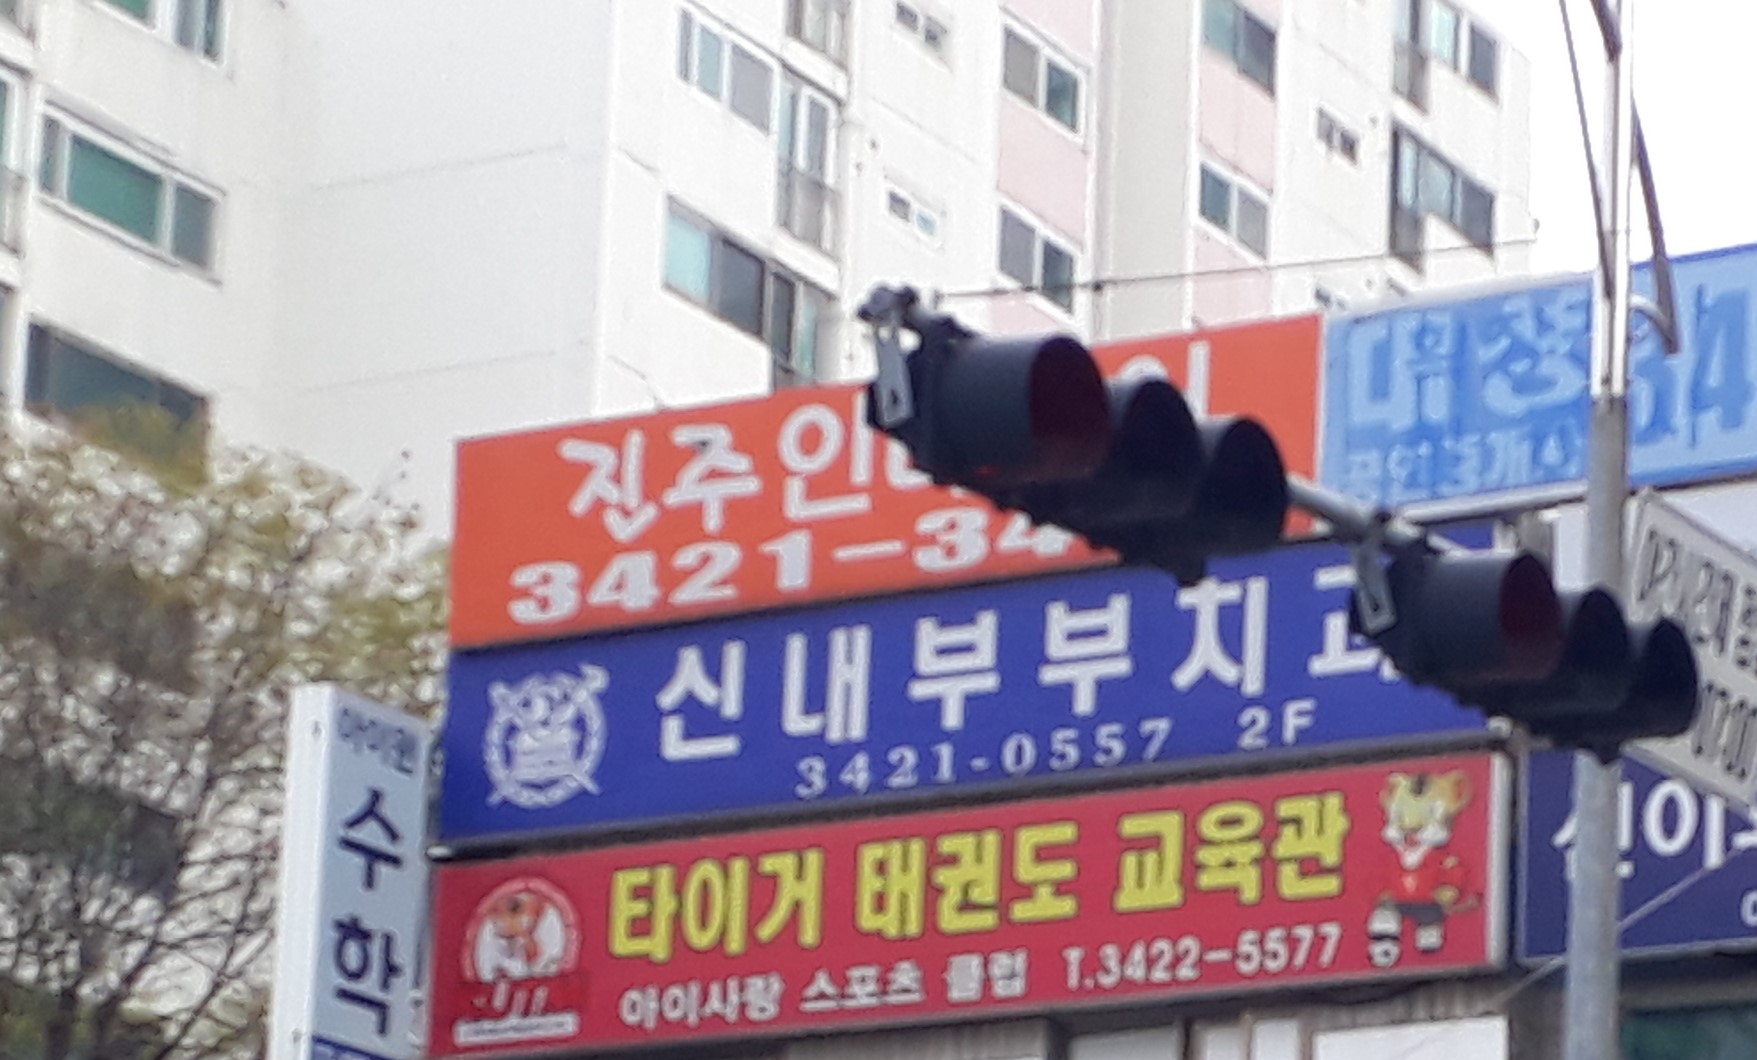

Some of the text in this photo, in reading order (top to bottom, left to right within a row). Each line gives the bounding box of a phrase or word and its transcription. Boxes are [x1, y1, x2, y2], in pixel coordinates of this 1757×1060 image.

[508, 506, 1073, 626] 3421-34
[794, 698, 1319, 801] 3421-0557 2F
[334, 786, 404, 1036] 수학
[609, 790, 1352, 963] 타이거 태권도 교육관
[619, 971, 784, 1030] 아이사랑
[799, 957, 926, 1012] 스포츠
